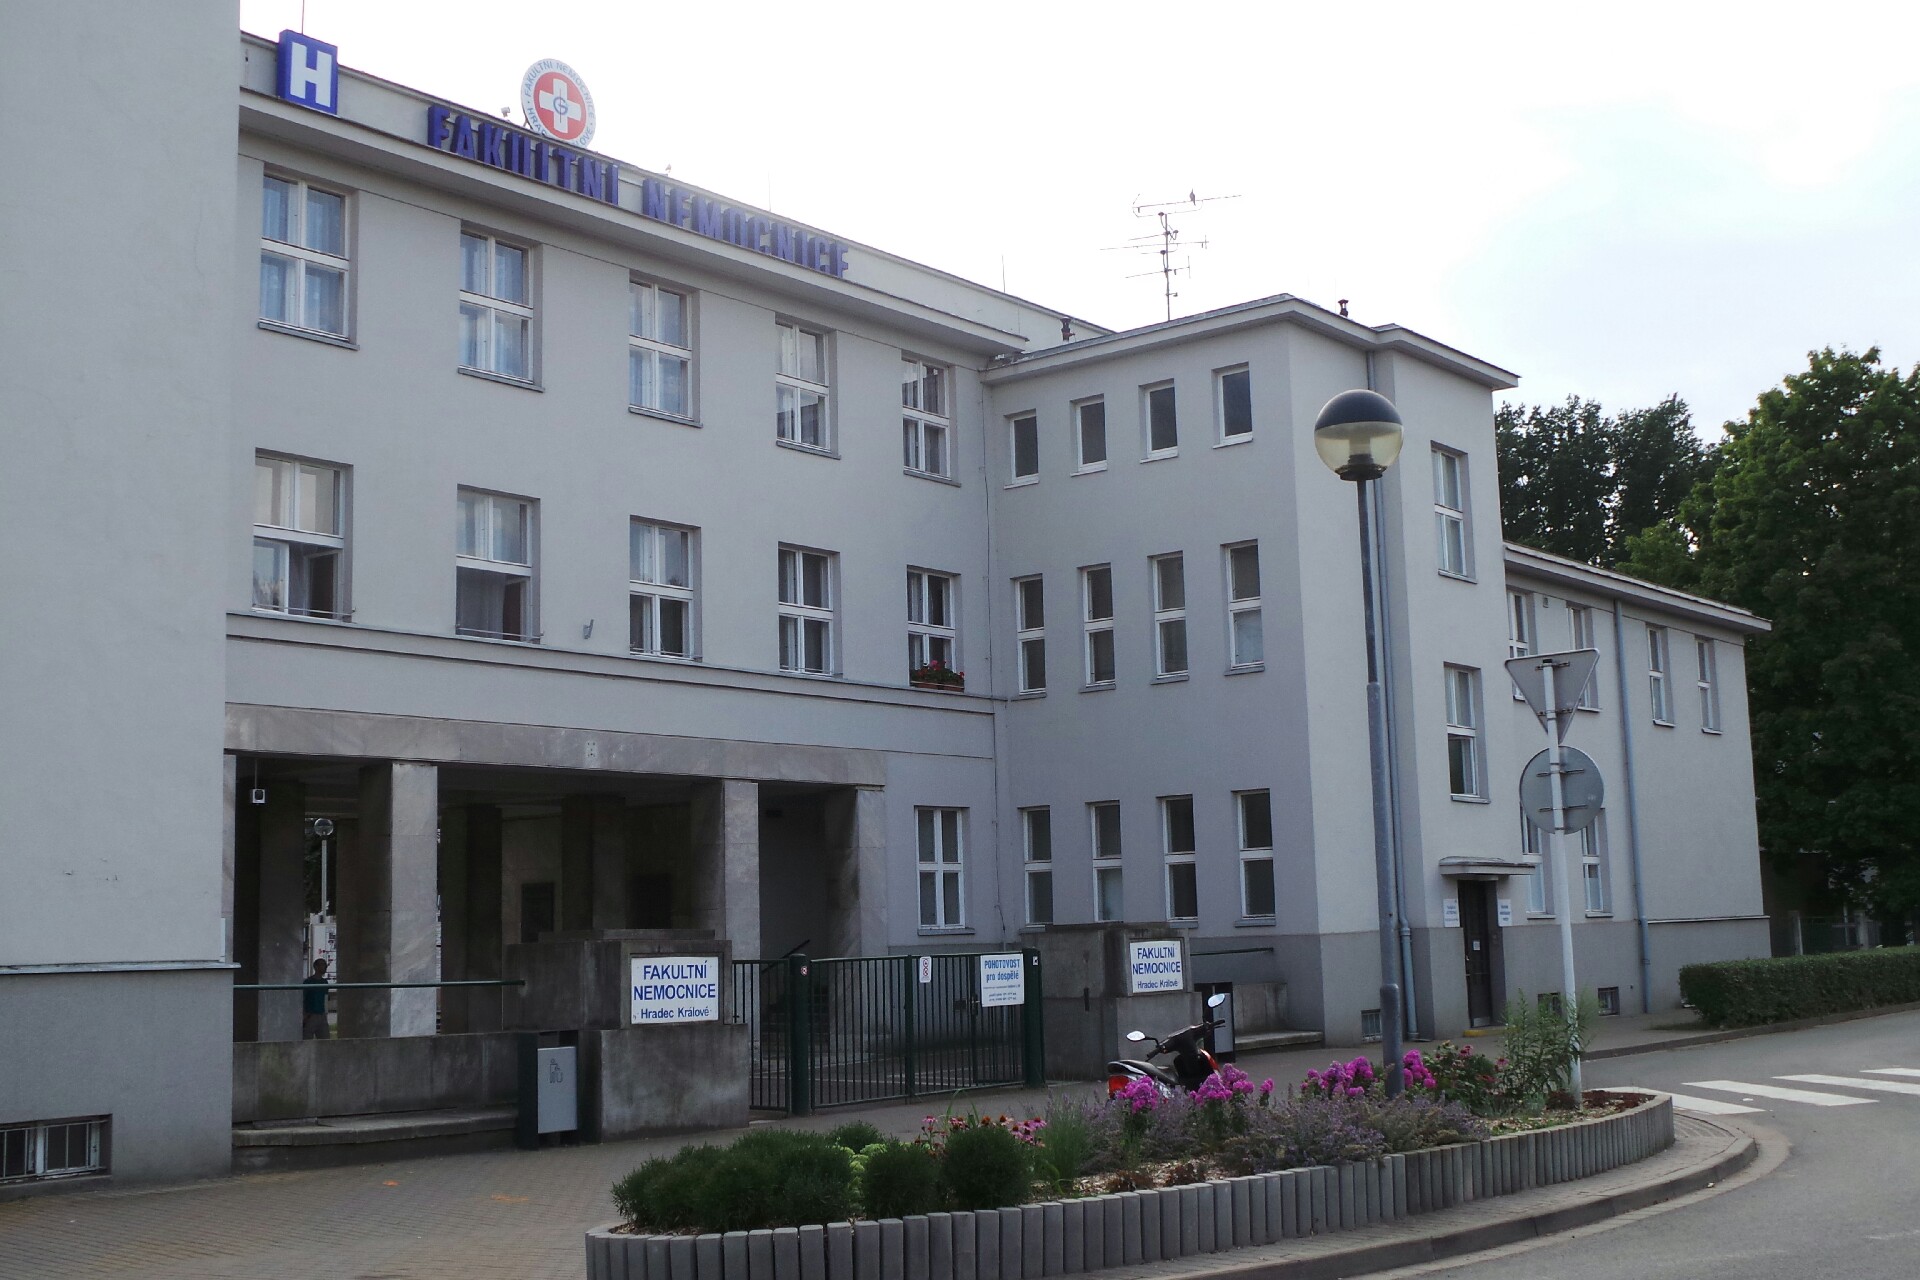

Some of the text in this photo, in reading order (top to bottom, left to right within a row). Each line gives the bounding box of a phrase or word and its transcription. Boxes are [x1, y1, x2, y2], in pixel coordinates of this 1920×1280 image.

[290, 42, 332, 108] H
[556, 62, 595, 119] NEMOCNICE
[642, 178, 849, 278] NEMOCNICE
[1137, 944, 1175, 959] FAKULTNÍ
[643, 960, 708, 980] FAKULTNÍ
[984, 959, 1020, 969] POHOTOVOST
[1132, 961, 1181, 975] NEMOCNICE
[986, 970, 1020, 983] pro dospělé
[633, 983, 716, 1001] NEMOCNICE
[1137, 980, 1158, 989] Hradec
[641, 1006, 710, 1019] Hradec Králové
